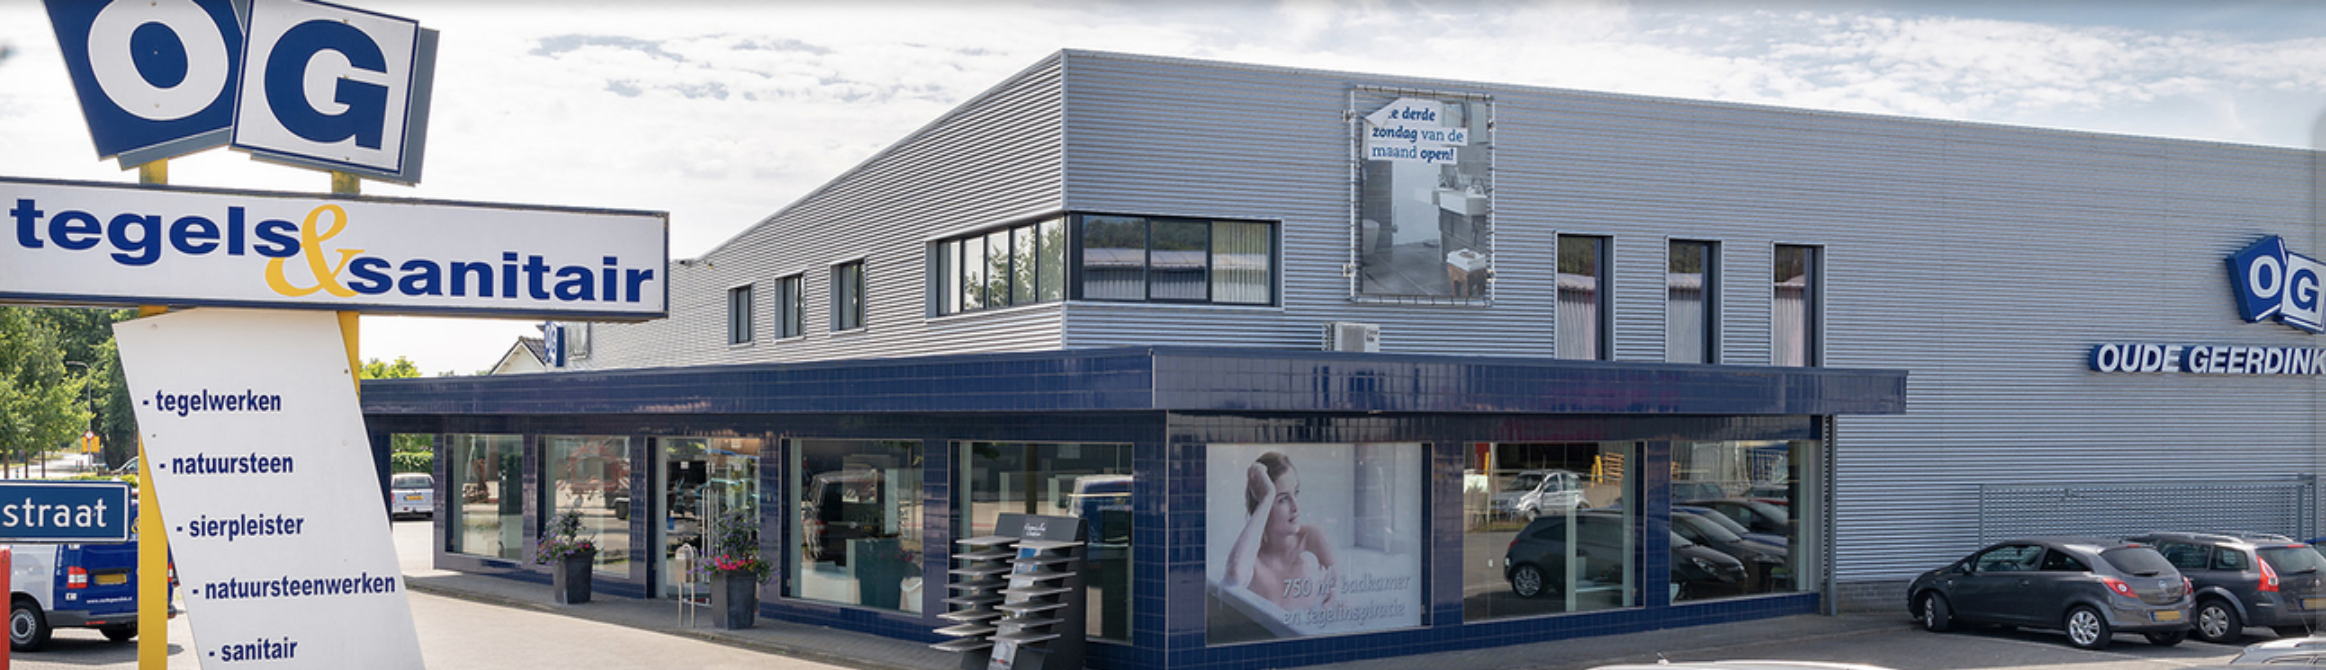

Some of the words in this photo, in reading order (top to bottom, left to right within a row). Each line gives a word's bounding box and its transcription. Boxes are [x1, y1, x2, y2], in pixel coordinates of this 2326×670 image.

[1402, 106, 1436, 121] derde
[1372, 125, 1418, 143] zondag
[1421, 130, 1445, 142] van
[1447, 129, 1465, 142] de
[1372, 146, 1418, 159] maand
[1420, 148, 1454, 163] open!
[10, 199, 301, 266] tegels
[347, 251, 655, 303] sanitair
[2249, 254, 2320, 314] OG
[2096, 343, 2183, 373] OUDE
[2188, 345, 2326, 375] GEERDINK
[156, 389, 281, 417] tegelwerken
[172, 452, 294, 475] natuursteen
[2, 497, 107, 528] straat
[189, 514, 304, 541] sierpleister
[205, 572, 396, 600] natuursteenwerken
[1283, 578, 1312, 598] 750
[1340, 572, 1411, 594] badkamer
[1283, 611, 1301, 626] en
[221, 636, 298, 662] sanitair
